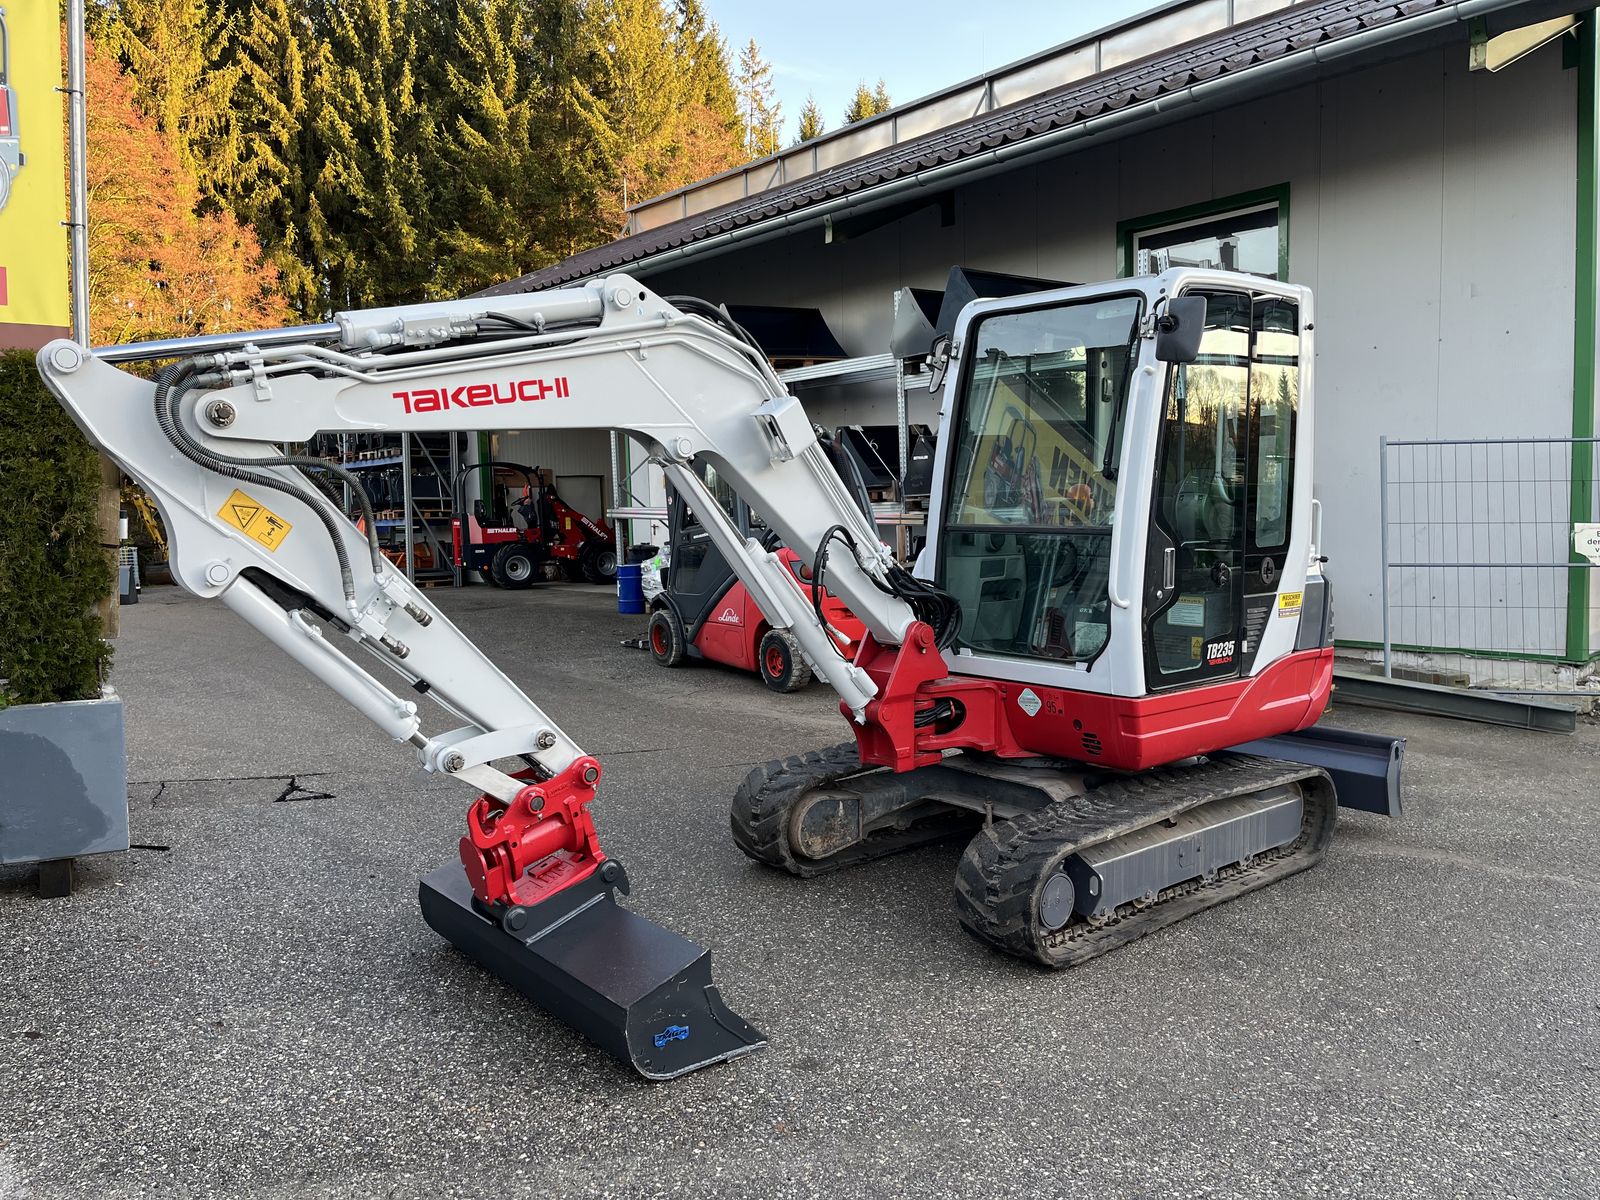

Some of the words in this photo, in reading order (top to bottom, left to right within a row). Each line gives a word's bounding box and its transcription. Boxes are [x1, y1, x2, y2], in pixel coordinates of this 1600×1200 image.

[392, 377, 570, 414] TAKEUCHI
[718, 608, 739, 623] Linde
[1207, 641, 1235, 660] TB235
[1046, 701, 1057, 714] 95
